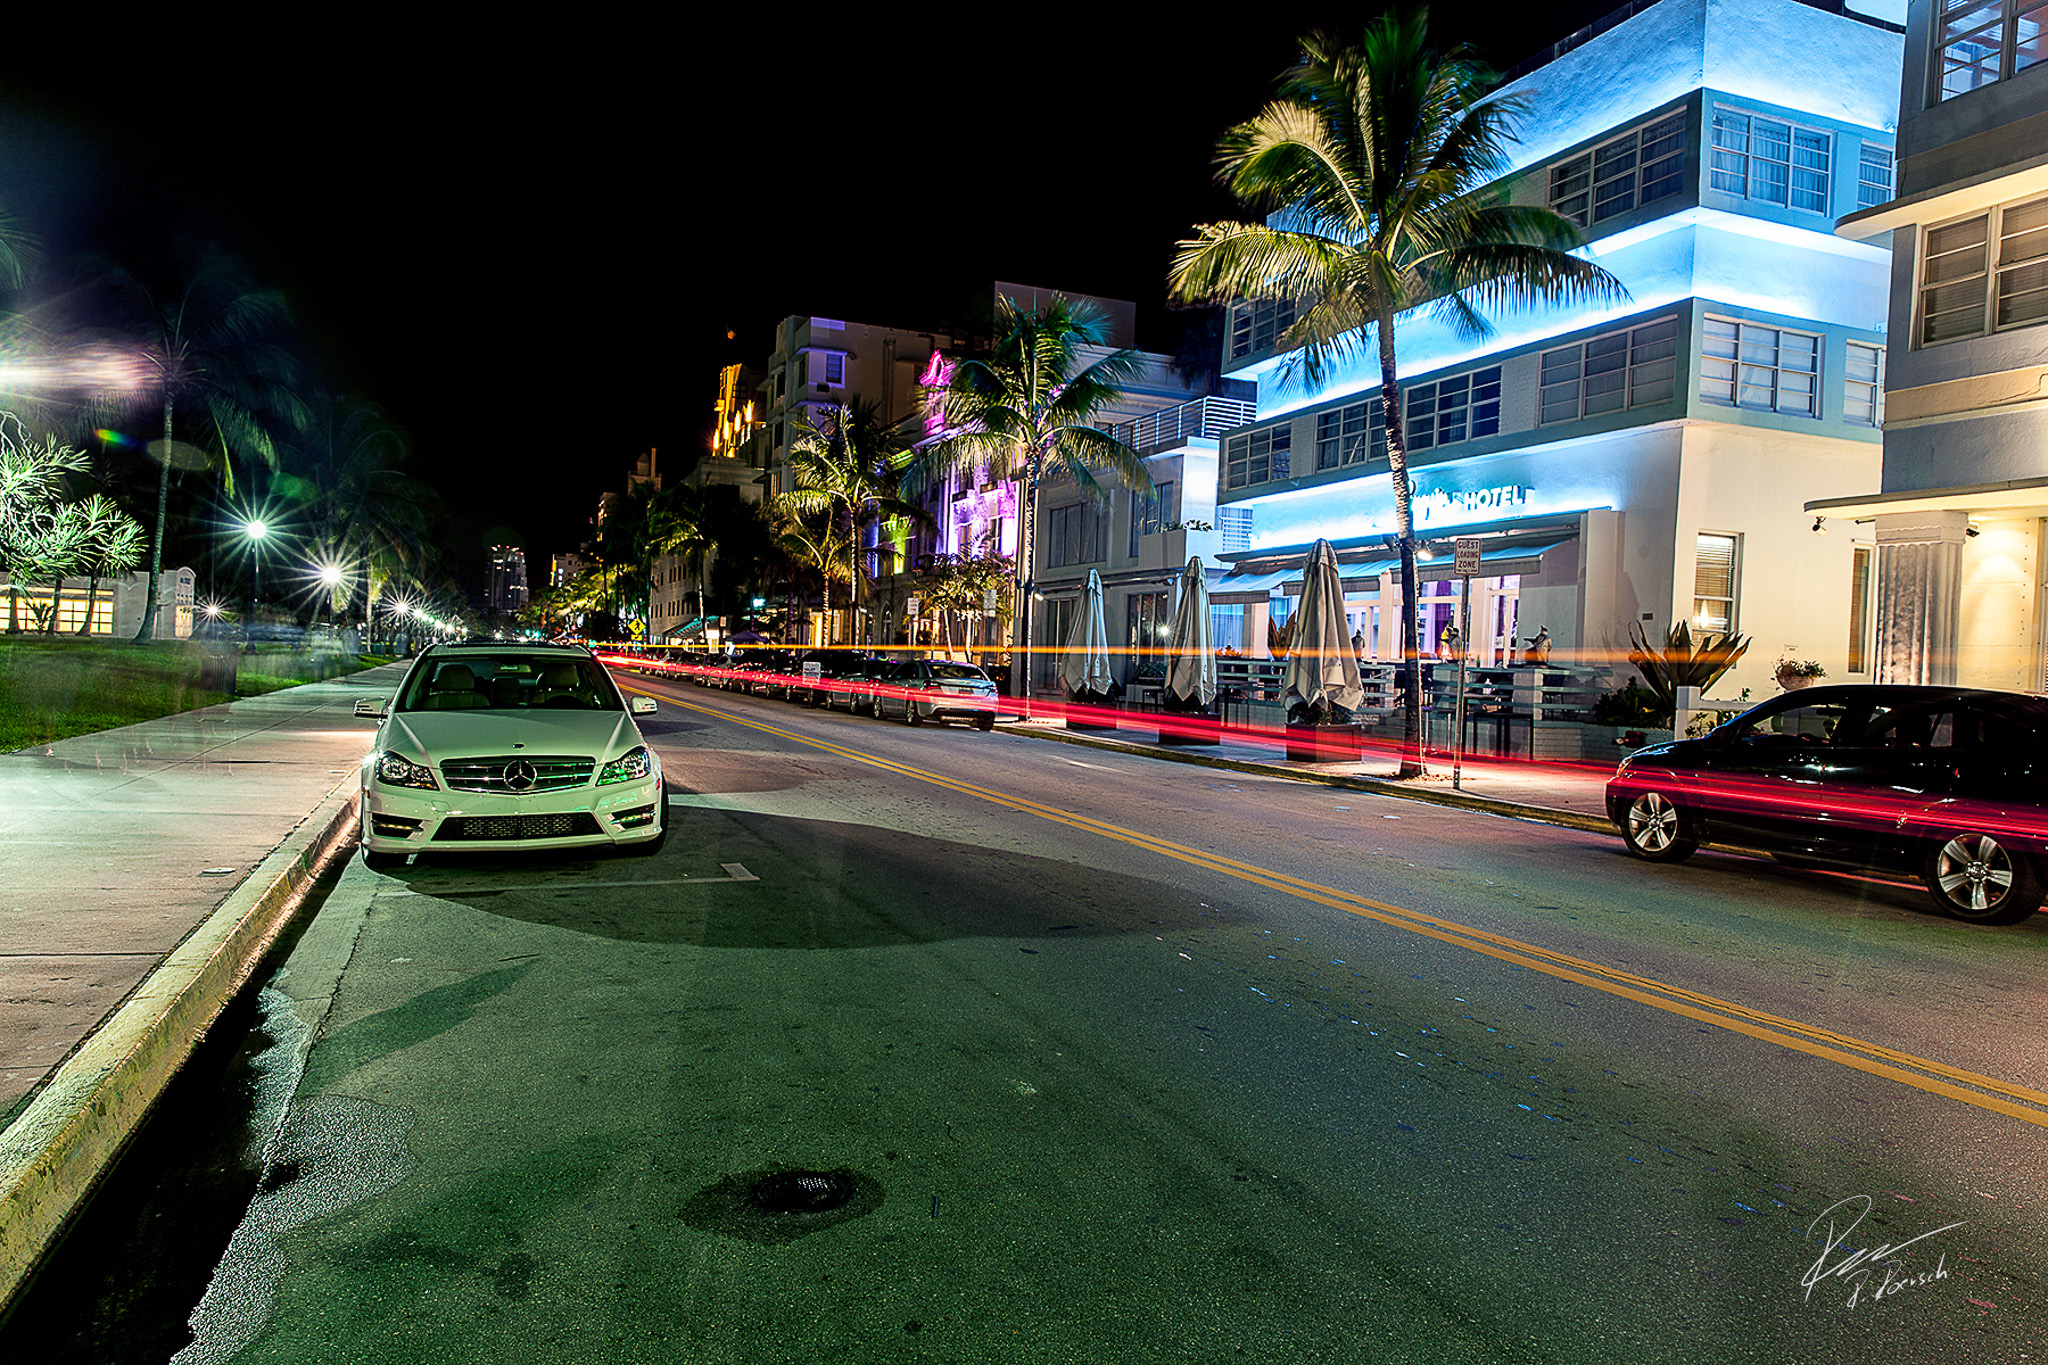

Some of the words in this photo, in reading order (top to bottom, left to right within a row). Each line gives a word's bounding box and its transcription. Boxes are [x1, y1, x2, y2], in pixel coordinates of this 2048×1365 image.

[1464, 485, 1523, 511] HOTEL
[1457, 541, 1479, 549] GUEST
[1458, 560, 1477, 569] ZONE
